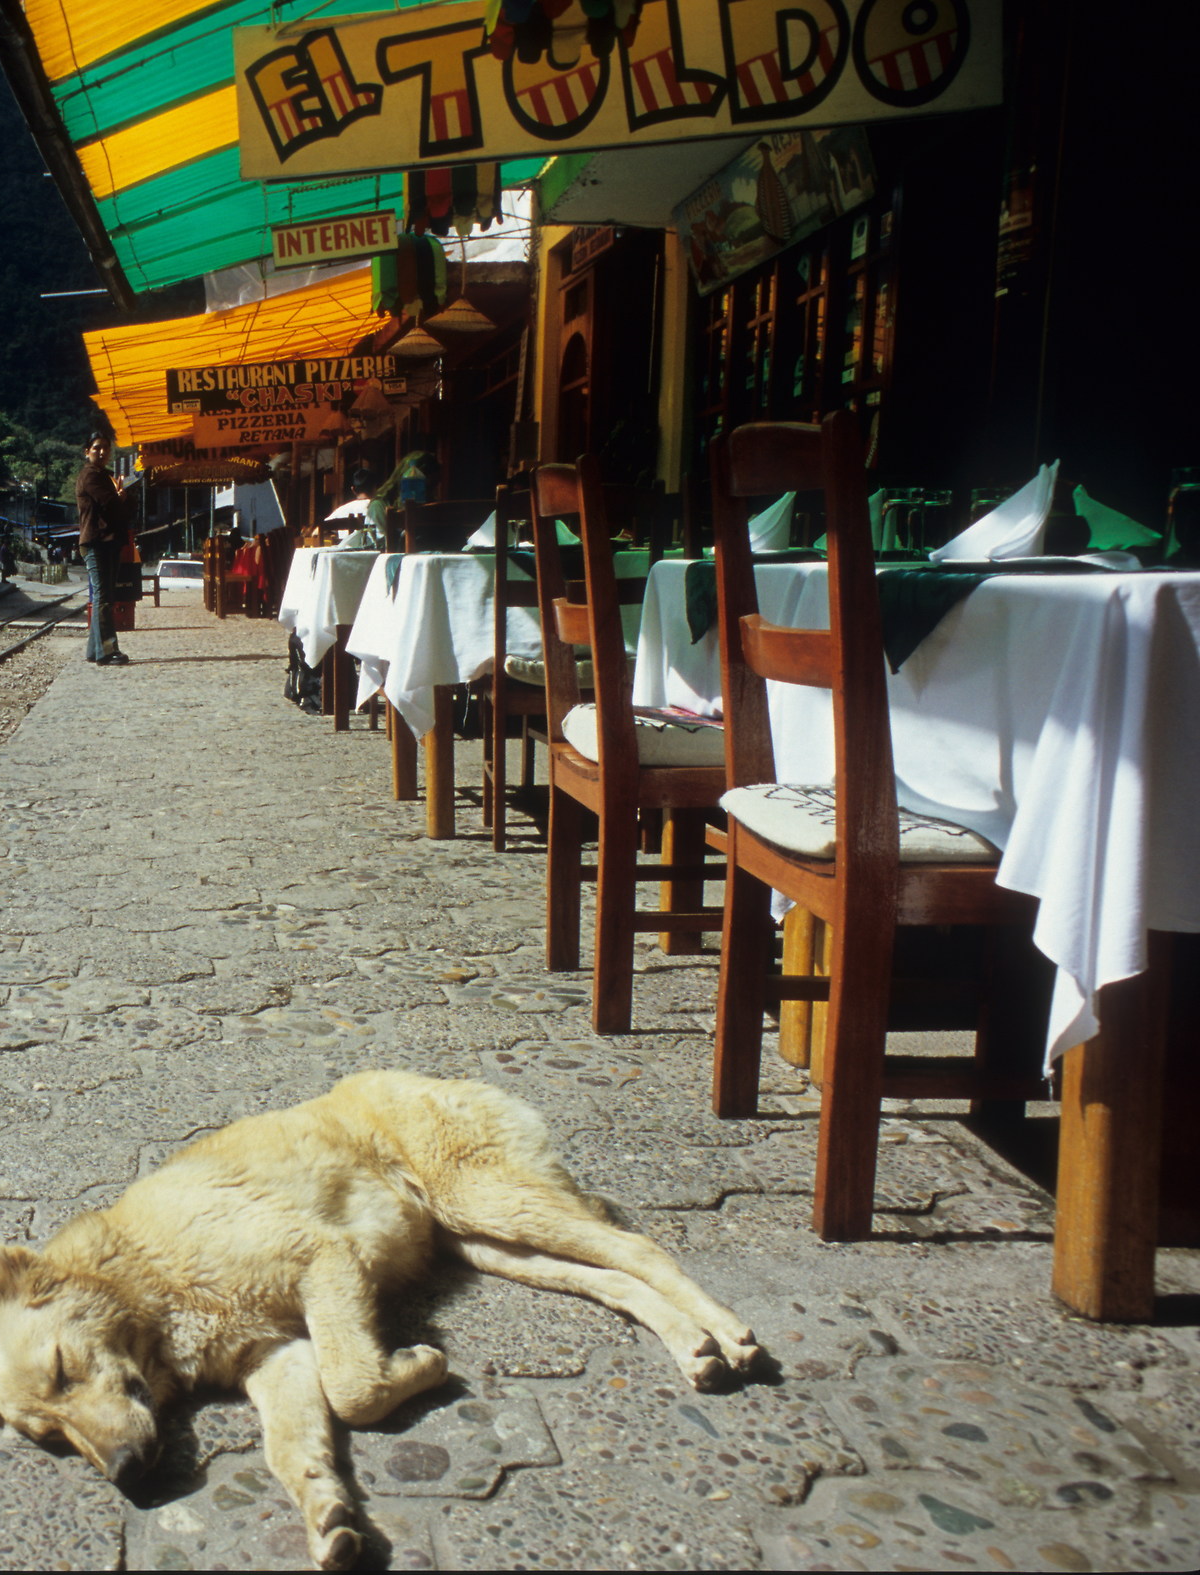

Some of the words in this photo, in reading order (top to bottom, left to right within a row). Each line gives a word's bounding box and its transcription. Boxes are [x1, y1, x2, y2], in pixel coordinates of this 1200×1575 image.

[244, 26, 384, 164] EL
[377, 0, 970, 158] TOLDO
[277, 216, 391, 258] INTERNET
[177, 362, 297, 393] RESTAURANT
[304, 355, 397, 384] PIZZERIA
[217, 412, 307, 430] PIZZERIA
[240, 427, 306, 443] RETAMA
